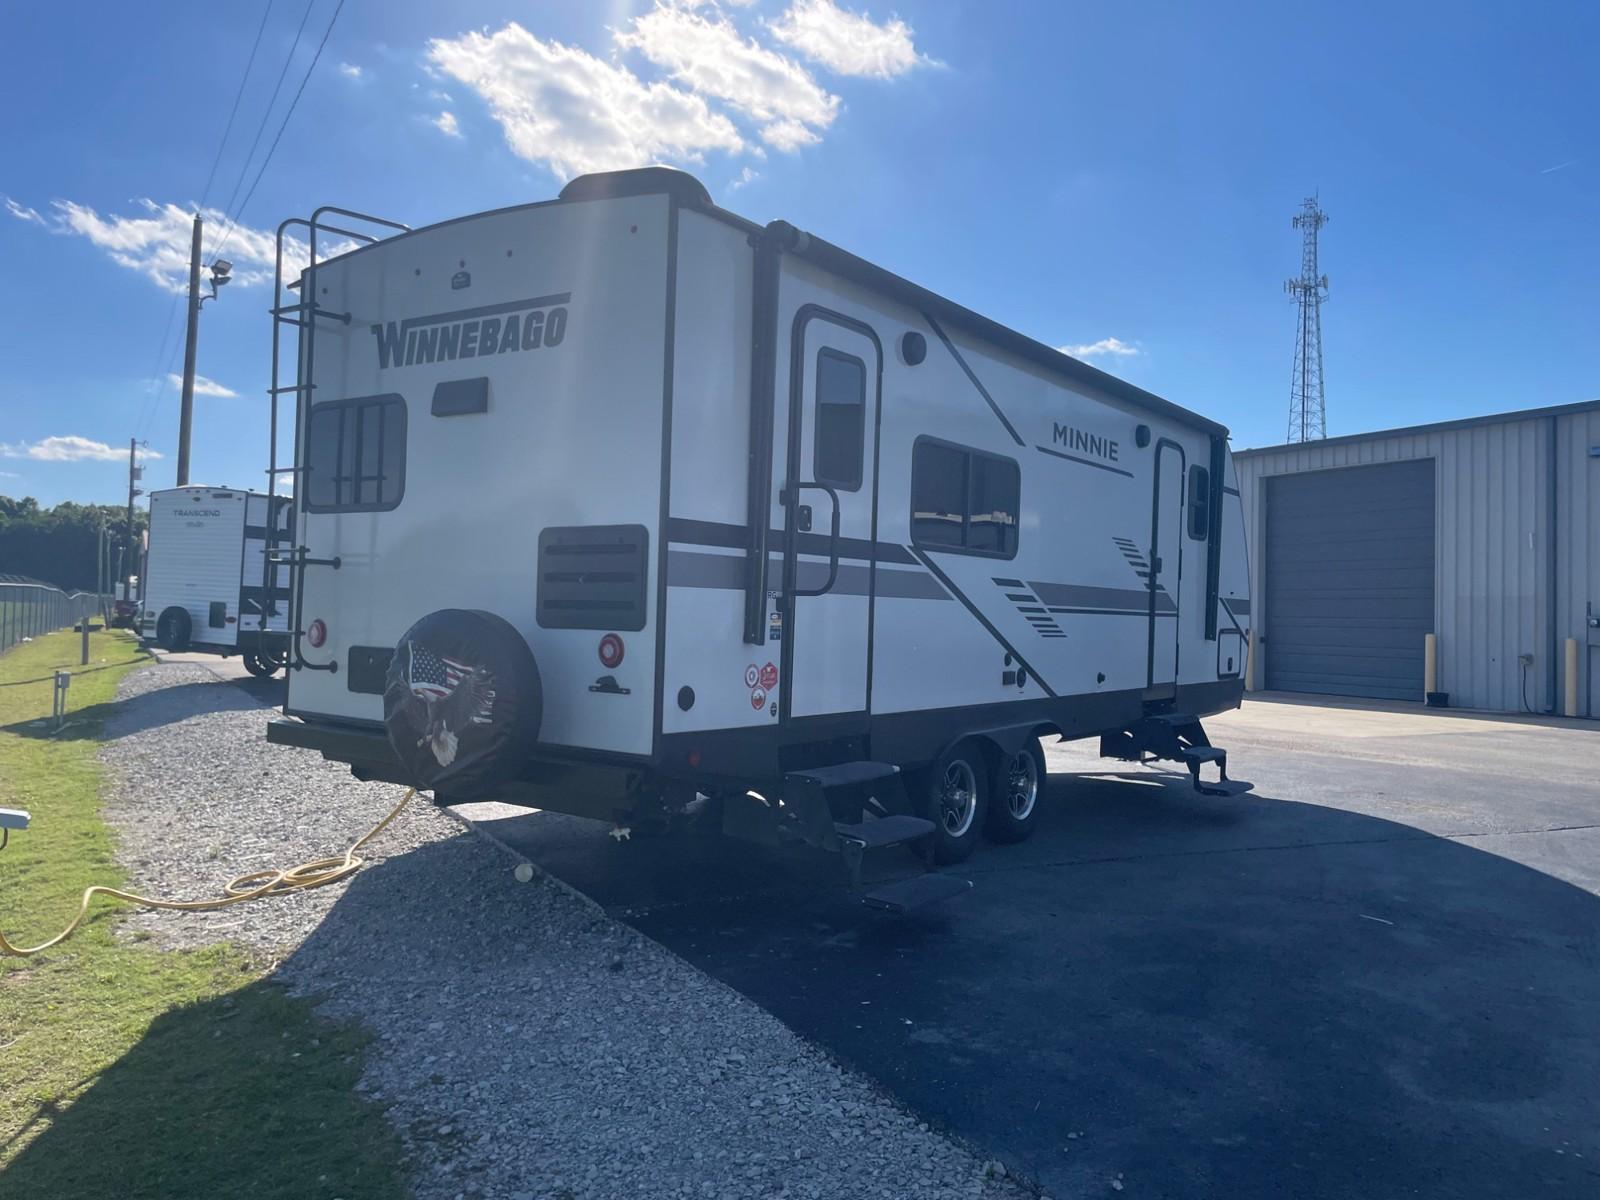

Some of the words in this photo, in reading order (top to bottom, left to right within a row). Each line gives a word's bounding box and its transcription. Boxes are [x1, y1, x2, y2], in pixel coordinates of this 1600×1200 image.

[371, 305, 569, 369] WINNEBAGO
[1053, 421, 1119, 461] MINNIE
[173, 509, 221, 517] TRANSCEND
